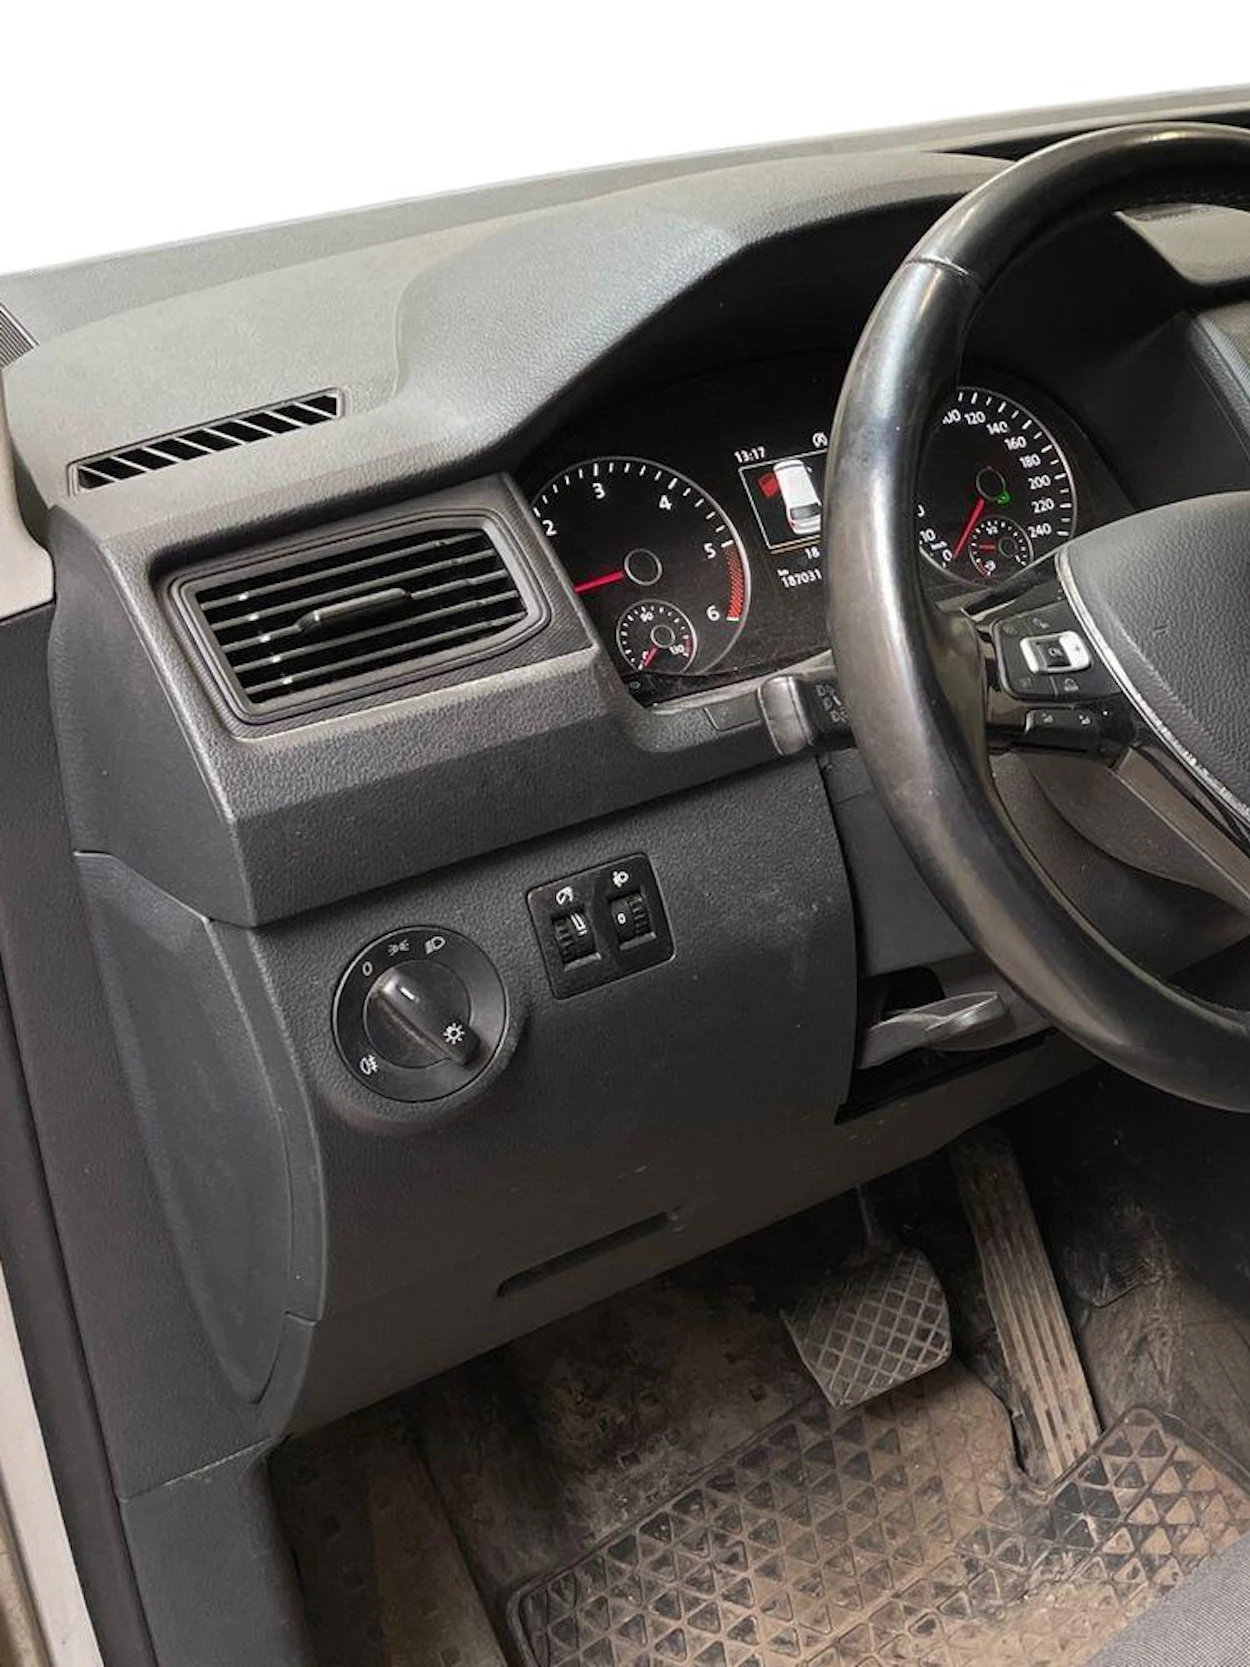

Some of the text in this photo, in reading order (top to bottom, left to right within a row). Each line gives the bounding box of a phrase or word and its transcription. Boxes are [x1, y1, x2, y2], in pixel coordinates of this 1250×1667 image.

[964, 411, 986, 425] 120
[986, 421, 1008, 435] 140
[1004, 436, 1027, 450] 160
[734, 446, 765, 463] 13:17
[1019, 453, 1042, 468] 180
[1028, 475, 1051, 490] 200
[592, 483, 606, 499] 3
[659, 494, 673, 511] 4
[1031, 498, 1055, 513] 220
[542, 519, 557, 536] 2
[920, 528, 936, 542] 10
[1028, 523, 1052, 538] 240
[703, 542, 716, 559] 5
[942, 549, 953, 561] 0
[781, 568, 822, 588] 187031
[706, 605, 720, 621] 6
[362, 960, 373, 976] 0
